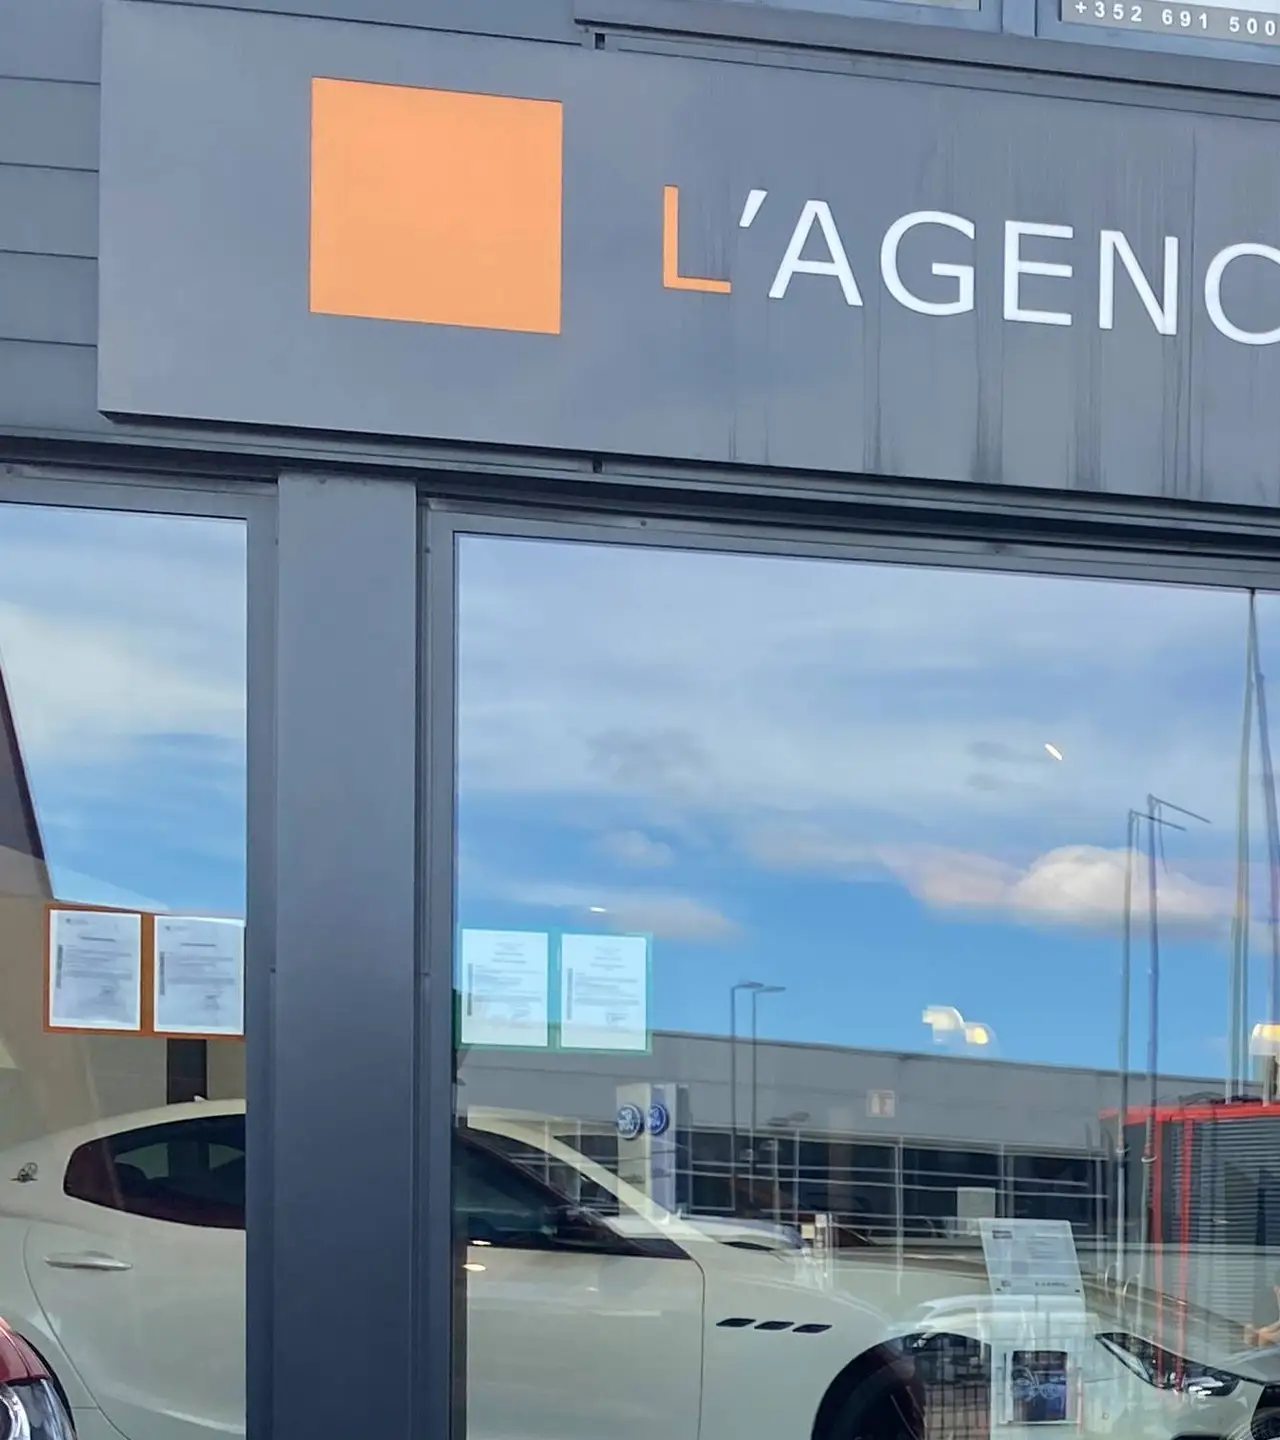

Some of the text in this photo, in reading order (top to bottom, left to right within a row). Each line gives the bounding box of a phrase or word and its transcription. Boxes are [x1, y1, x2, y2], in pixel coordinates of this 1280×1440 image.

[1075, 1, 1142, 22] +352
[1162, 9, 1208, 29] 691
[1229, 16, 1276, 36] 500
